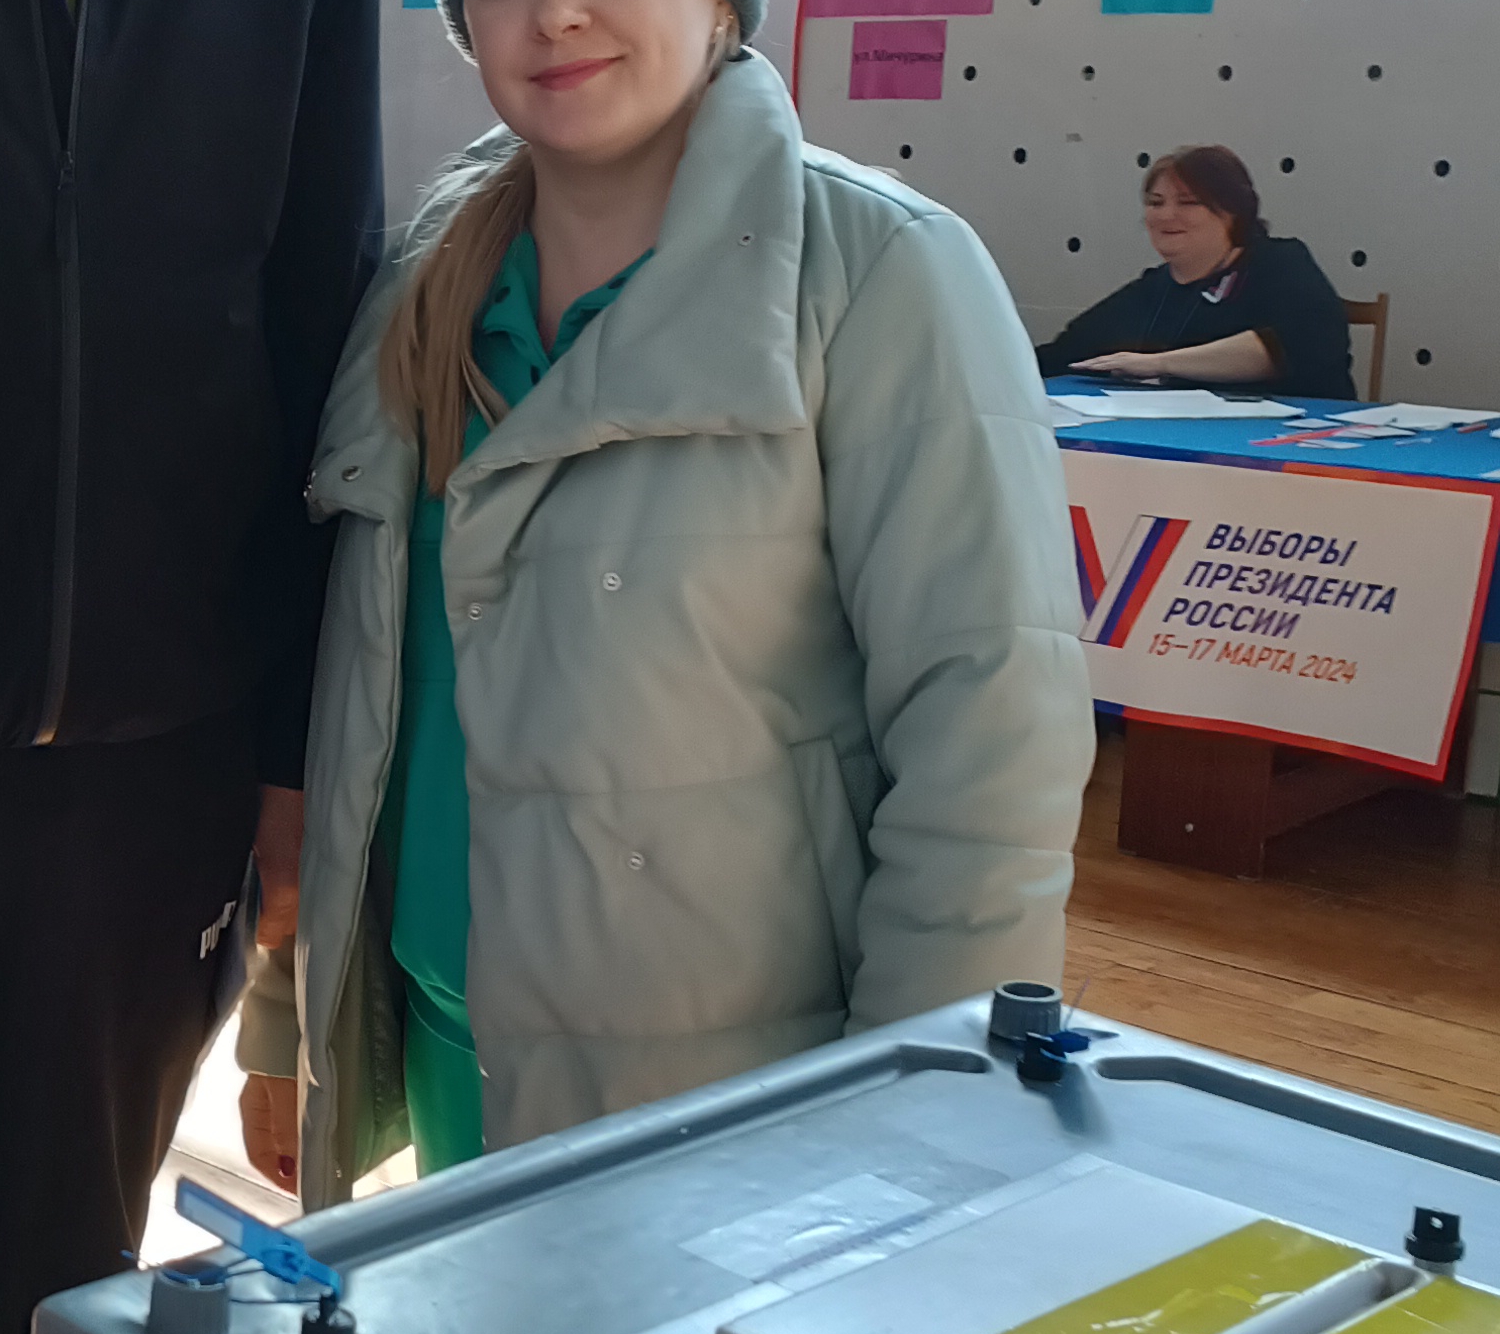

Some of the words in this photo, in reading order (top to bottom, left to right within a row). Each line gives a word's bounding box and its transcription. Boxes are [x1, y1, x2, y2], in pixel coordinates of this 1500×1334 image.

[1205, 522, 1358, 568] ВЫБОРЫ
[1183, 560, 1399, 616] ПРЕЗИДЕНТА
[1162, 597, 1301, 641] РОССИИ
[1217, 641, 1299, 676] МАРТА
[1297, 654, 1359, 685] 2024
